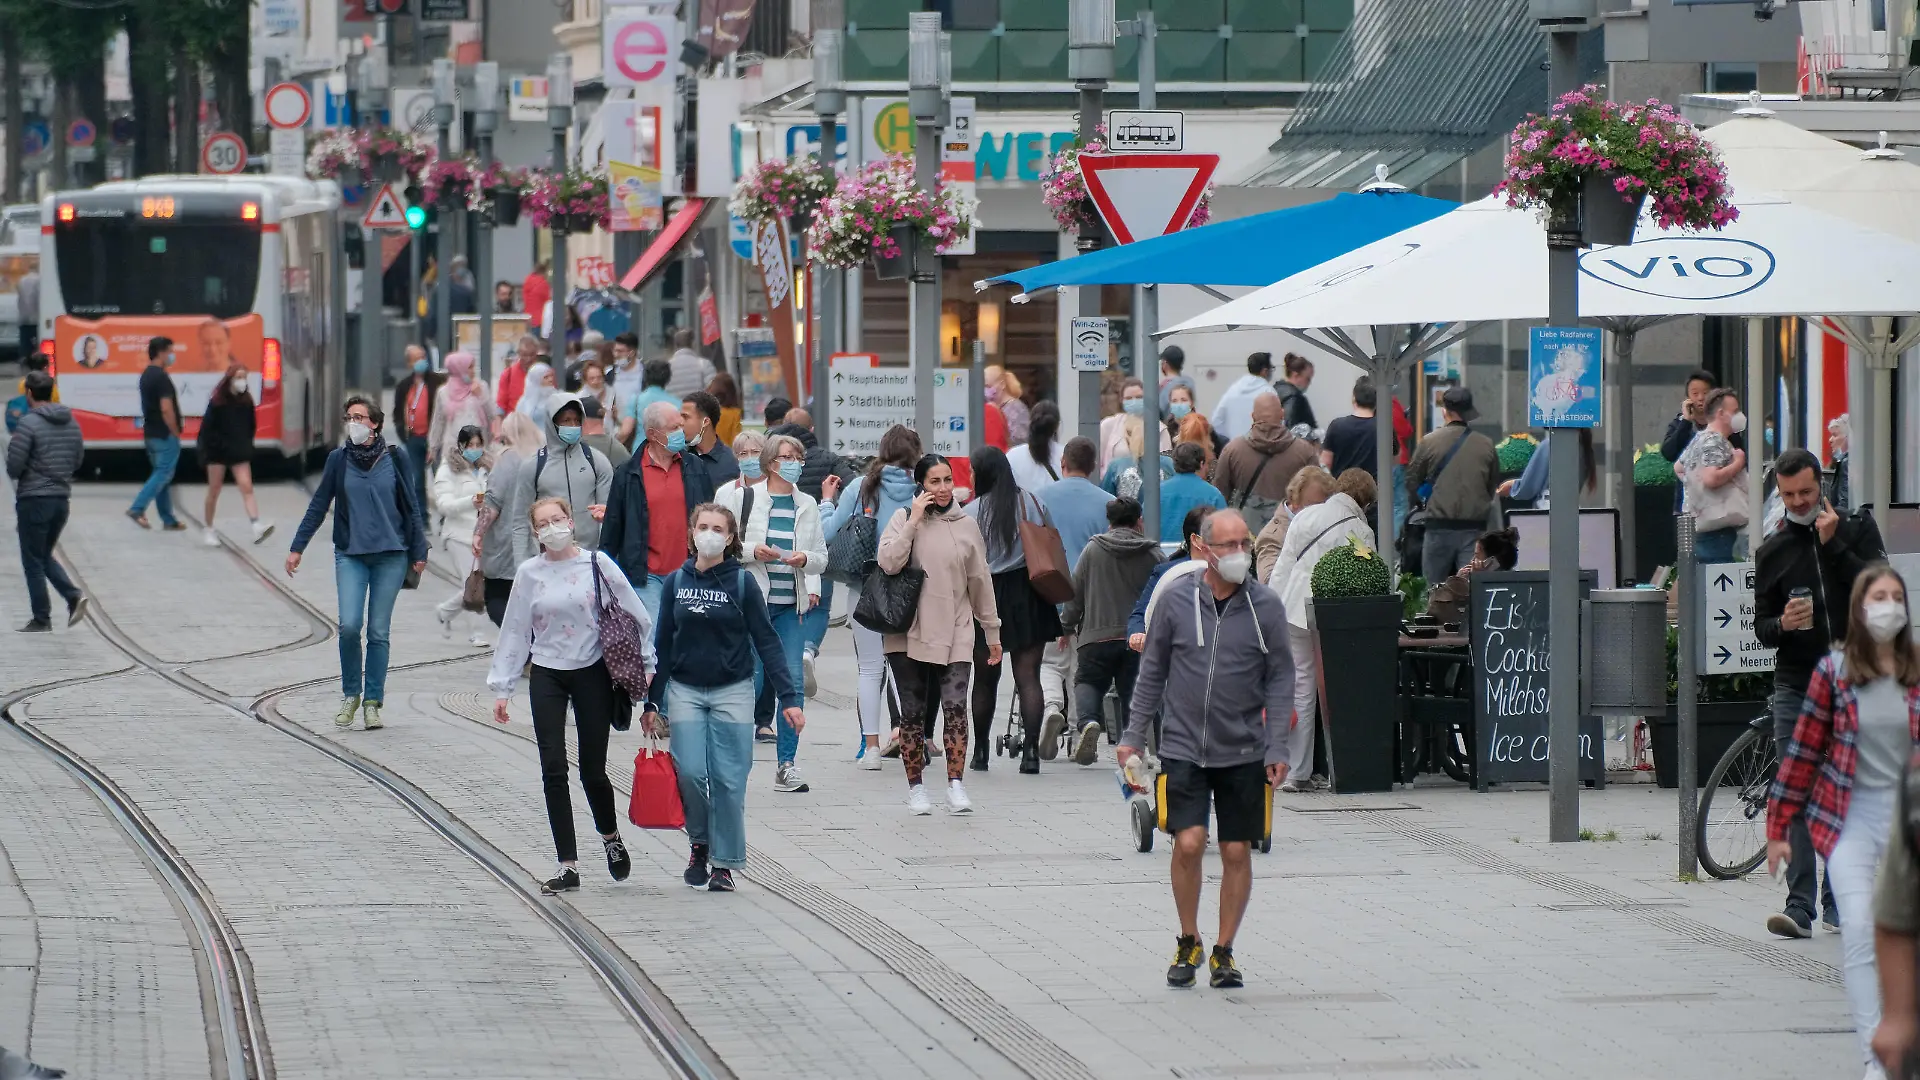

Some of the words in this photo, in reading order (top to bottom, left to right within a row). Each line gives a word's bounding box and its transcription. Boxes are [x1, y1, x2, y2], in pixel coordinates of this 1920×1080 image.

[613, 21, 668, 82] e
[211, 147, 238, 165] 30
[849, 373, 908, 387] Hauptbahnhof
[849, 395, 917, 408] Stadtbiblioth
[675, 588, 729, 603] HOLLISTER
[1739, 603, 1756, 615] Kau
[1740, 619, 1755, 631] Me
[1486, 675, 1551, 717] Milchs
[1489, 722, 1524, 763] Ice
